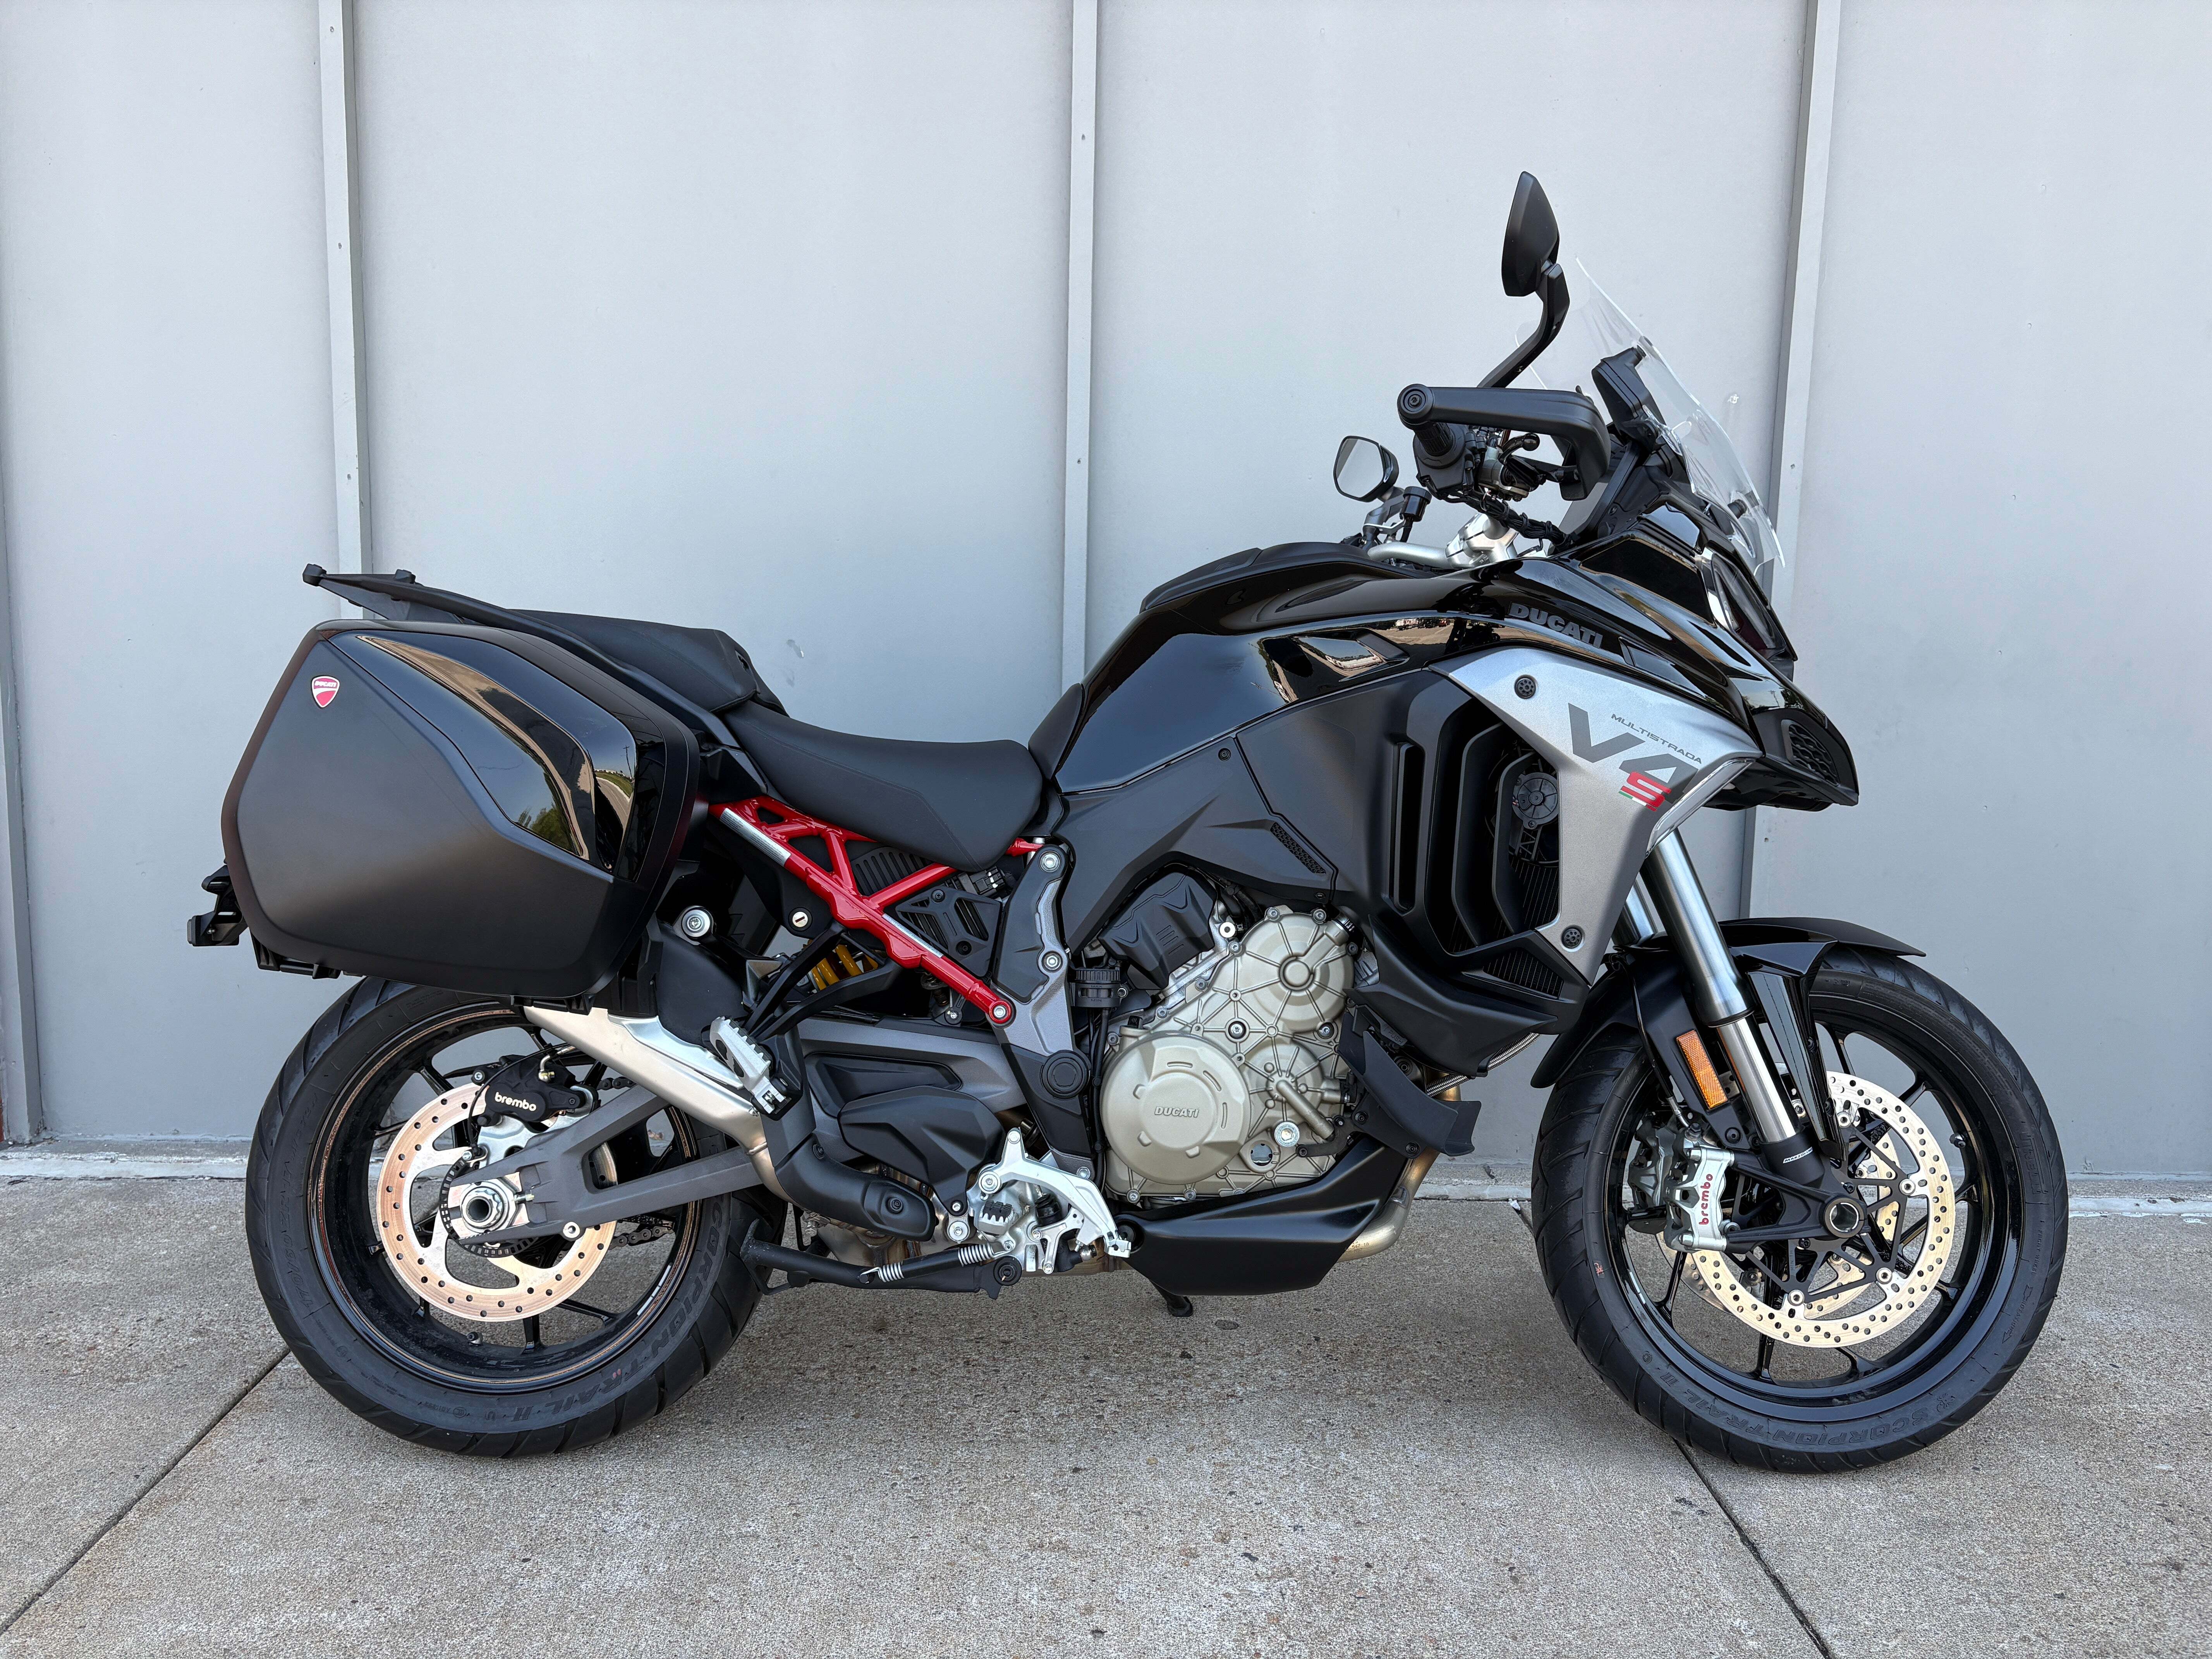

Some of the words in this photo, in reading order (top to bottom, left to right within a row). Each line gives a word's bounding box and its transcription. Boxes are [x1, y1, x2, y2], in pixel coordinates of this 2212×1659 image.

[1508, 602, 1603, 649] DUCATI
[1611, 714, 1702, 764] MULTISTRADA
[1388, 1030, 1404, 1045] PUSH
[495, 1092, 537, 1111] brembo
[1154, 1106, 1199, 1118] DUCATI
[1699, 1174, 1713, 1225] brembo
[651, 1202, 723, 1359] CORPION
[545, 1358, 643, 1415] TRAIL
[1684, 1389, 1764, 1437] TRAIL
[1772, 1407, 1929, 1445] SCORPION
